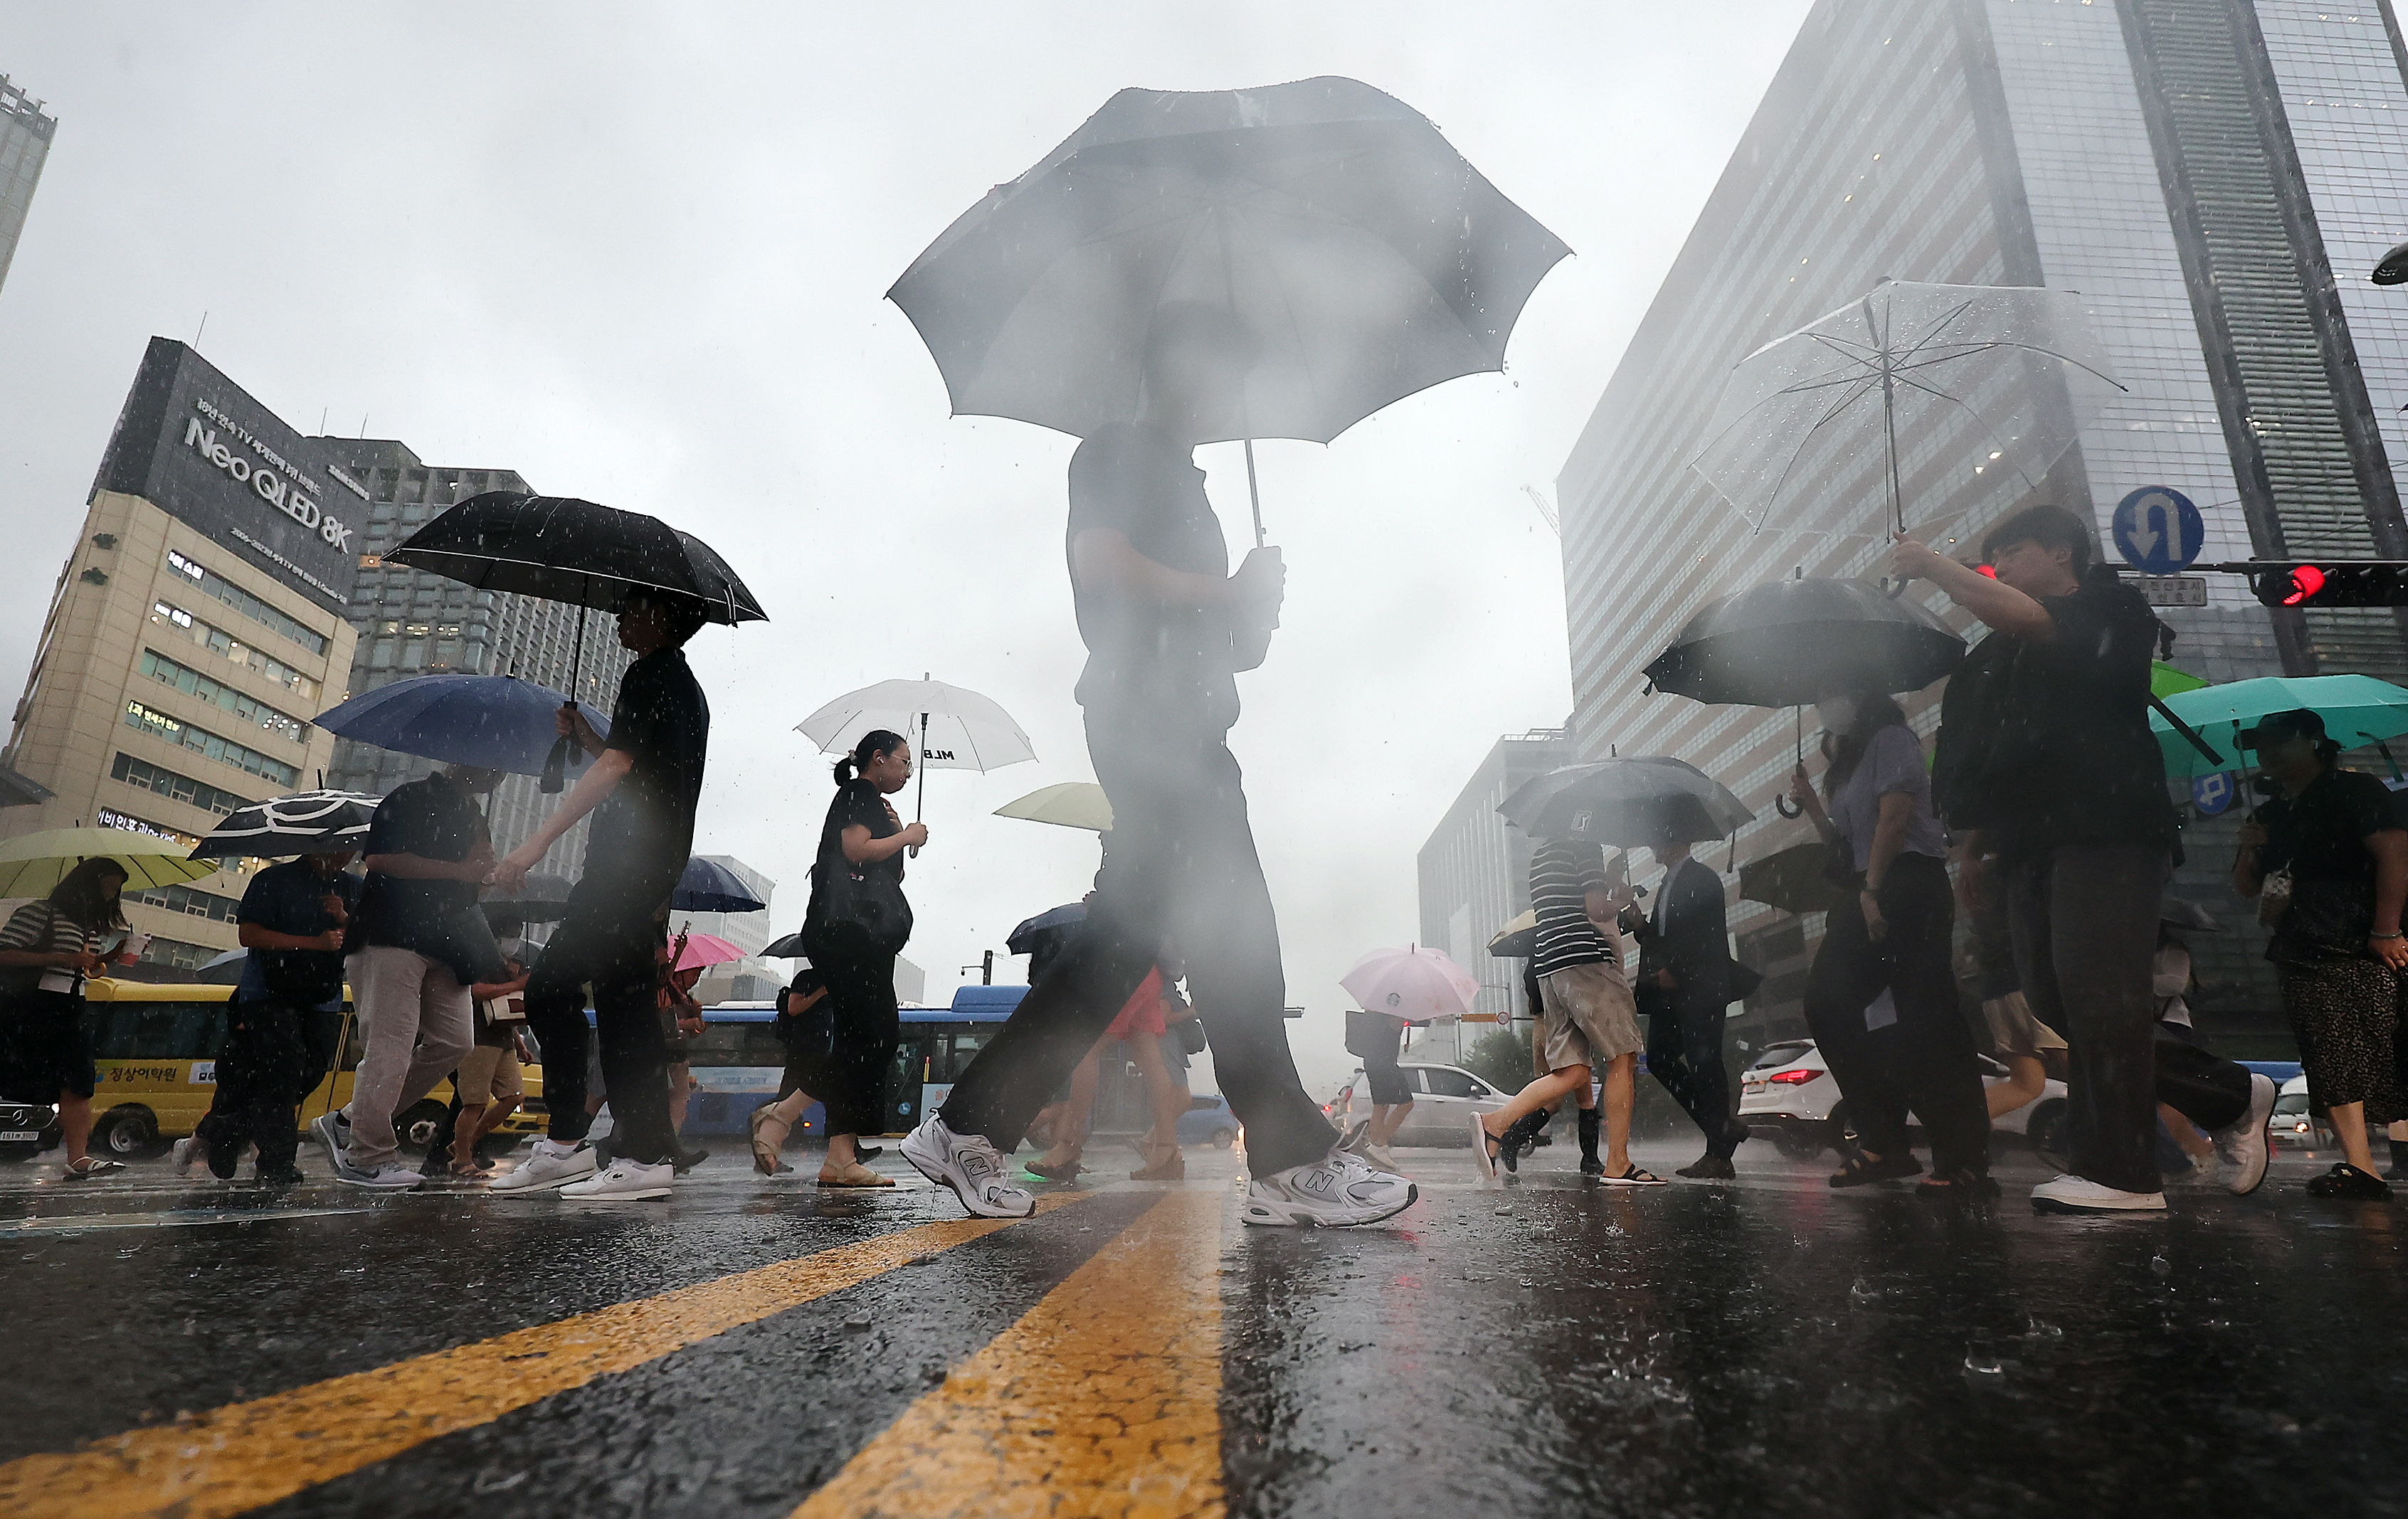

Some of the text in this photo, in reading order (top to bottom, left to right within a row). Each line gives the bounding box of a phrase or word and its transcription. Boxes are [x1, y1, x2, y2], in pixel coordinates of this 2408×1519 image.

[238, 427, 253, 445] TV
[184, 418, 353, 554] Neo QLED 8K
[110, 1067, 177, 1082] 정상어학원
[1305, 1170, 1334, 1192] N
